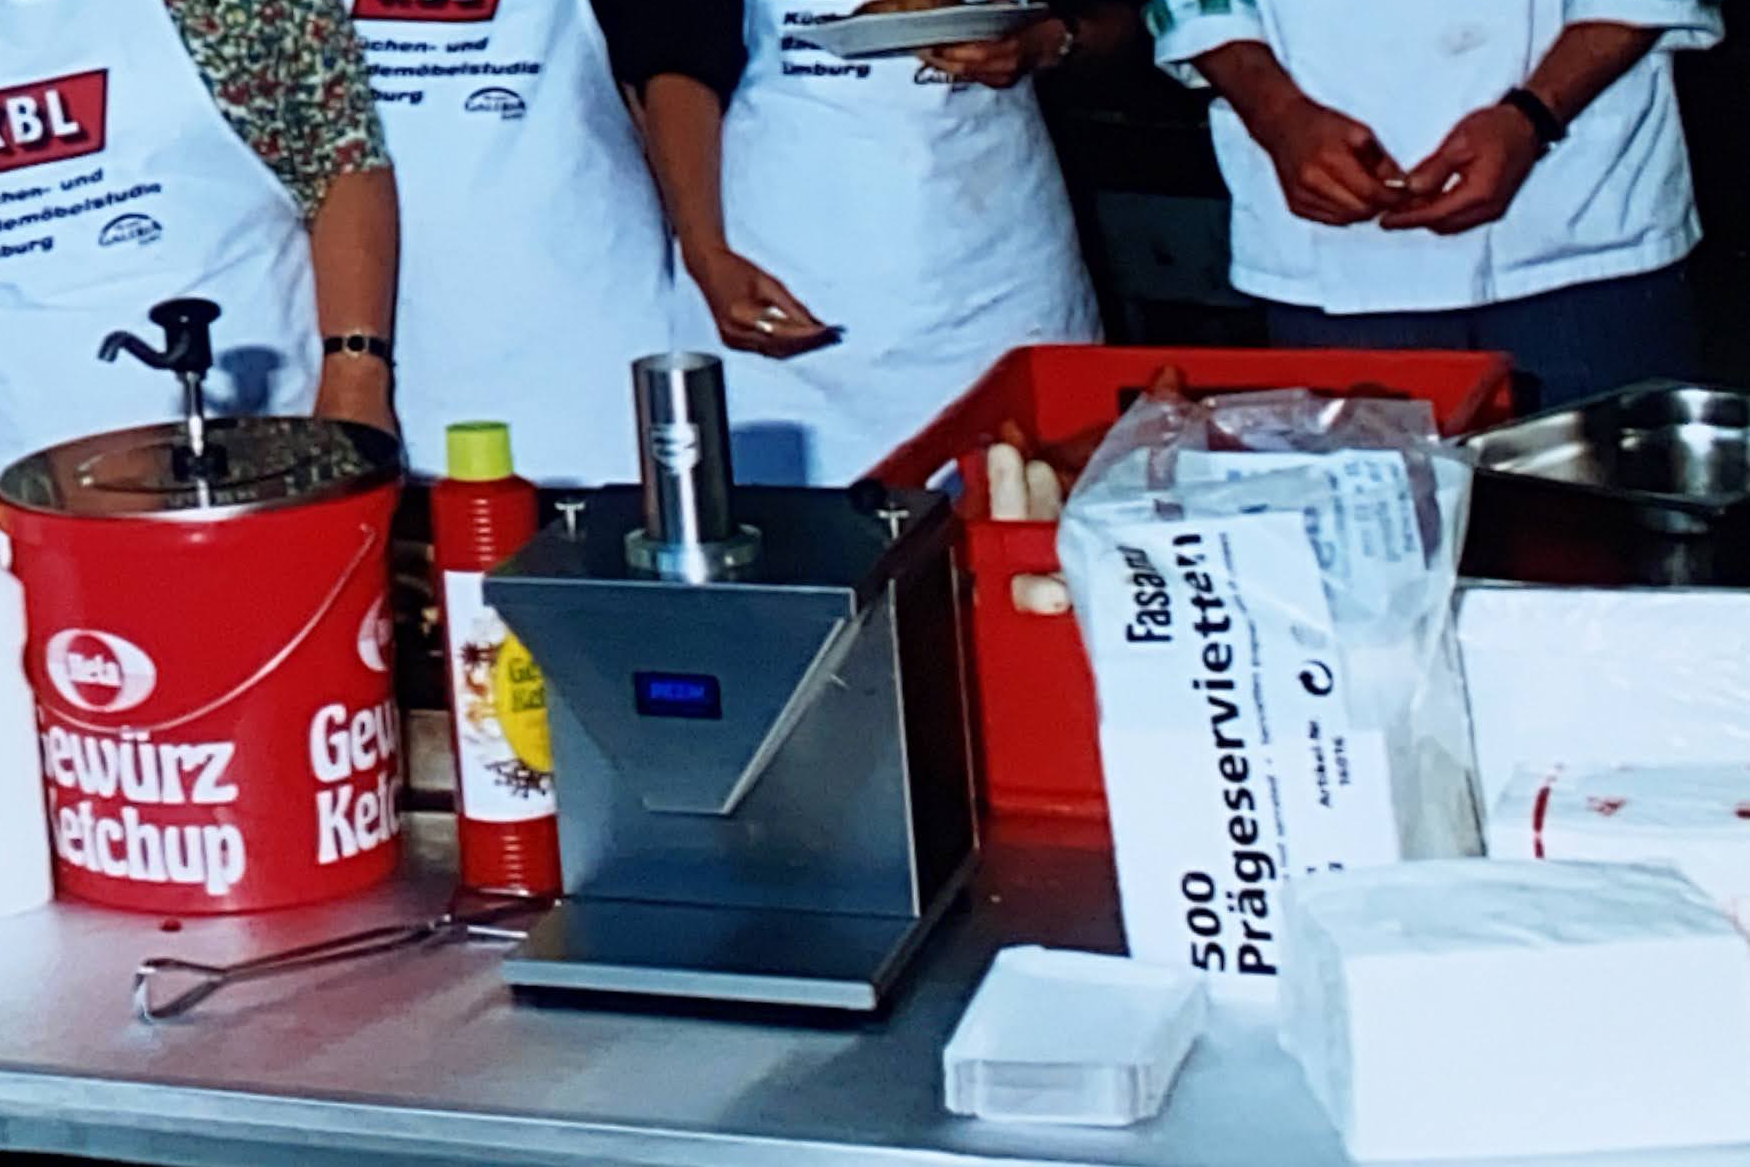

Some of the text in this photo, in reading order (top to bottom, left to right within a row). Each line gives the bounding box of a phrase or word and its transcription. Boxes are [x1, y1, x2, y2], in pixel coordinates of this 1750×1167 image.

[60, 168, 104, 191] und
[42, 725, 239, 804] ewürz
[50, 788, 246, 896] etchup
[1181, 871, 1226, 973] 500
